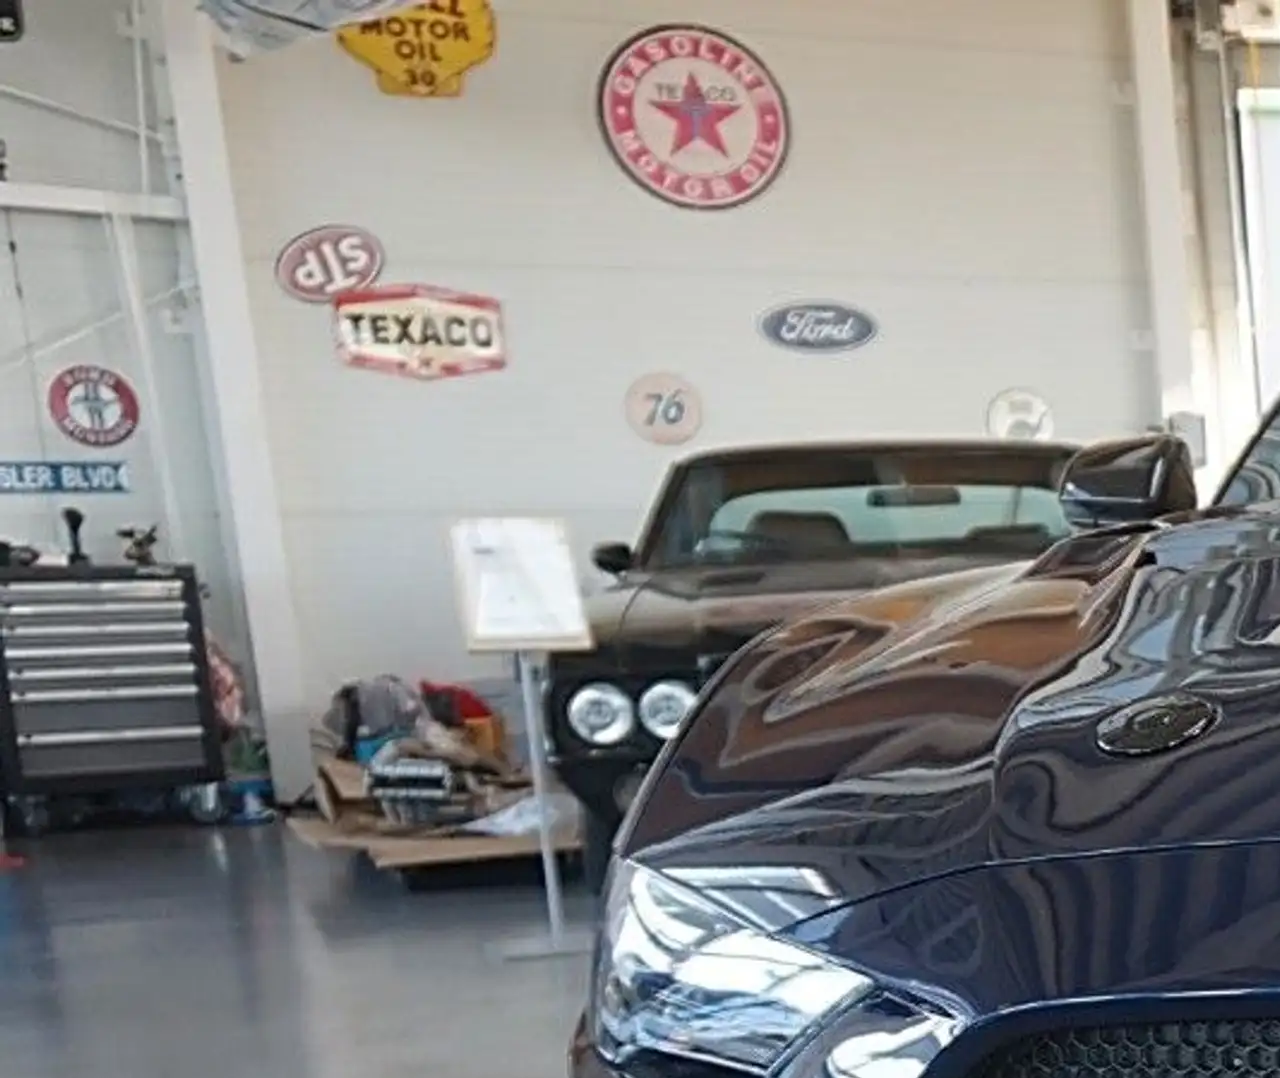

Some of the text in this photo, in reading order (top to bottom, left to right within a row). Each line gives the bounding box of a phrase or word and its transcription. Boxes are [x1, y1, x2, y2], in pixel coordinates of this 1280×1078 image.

[360, 17, 471, 41] MOTOR
[394, 40, 442, 61] OIL
[613, 36, 768, 96] GASOLIN
[621, 131, 734, 200] MOTOR
[739, 141, 778, 187] OIL
[343, 312, 493, 348] TEXACO
[780, 309, 857, 341] Ford
[642, 387, 685, 426] 76
